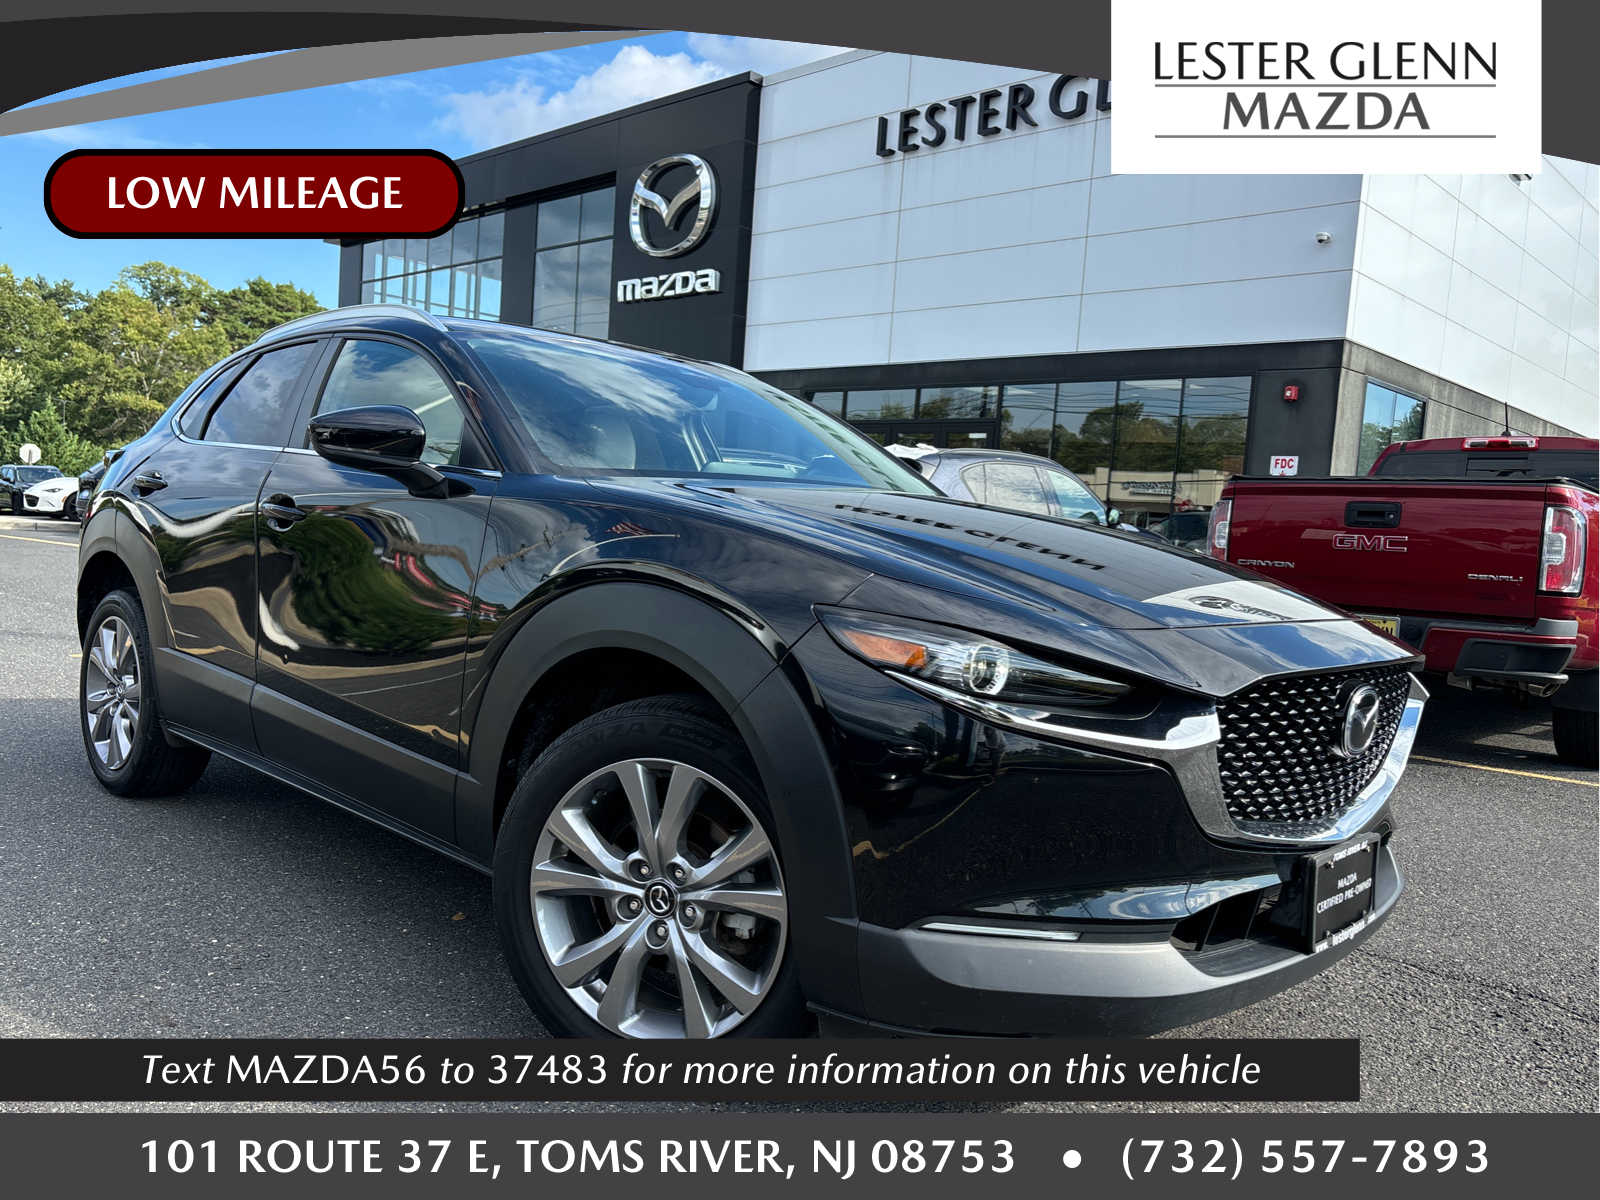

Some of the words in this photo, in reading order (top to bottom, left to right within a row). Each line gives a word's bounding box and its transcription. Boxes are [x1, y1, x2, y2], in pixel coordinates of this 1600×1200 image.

[876, 83, 1039, 158] LESTER
[1274, 458, 1294, 469] FDC
[1332, 533, 1408, 553] GMC
[1237, 558, 1295, 568] CANYON
[1467, 573, 1523, 582] DENALI
[1337, 872, 1358, 889] MAZDA
[1316, 892, 1344, 914] CERTIFIED
[1344, 877, 1372, 900] PRE-OWNED
